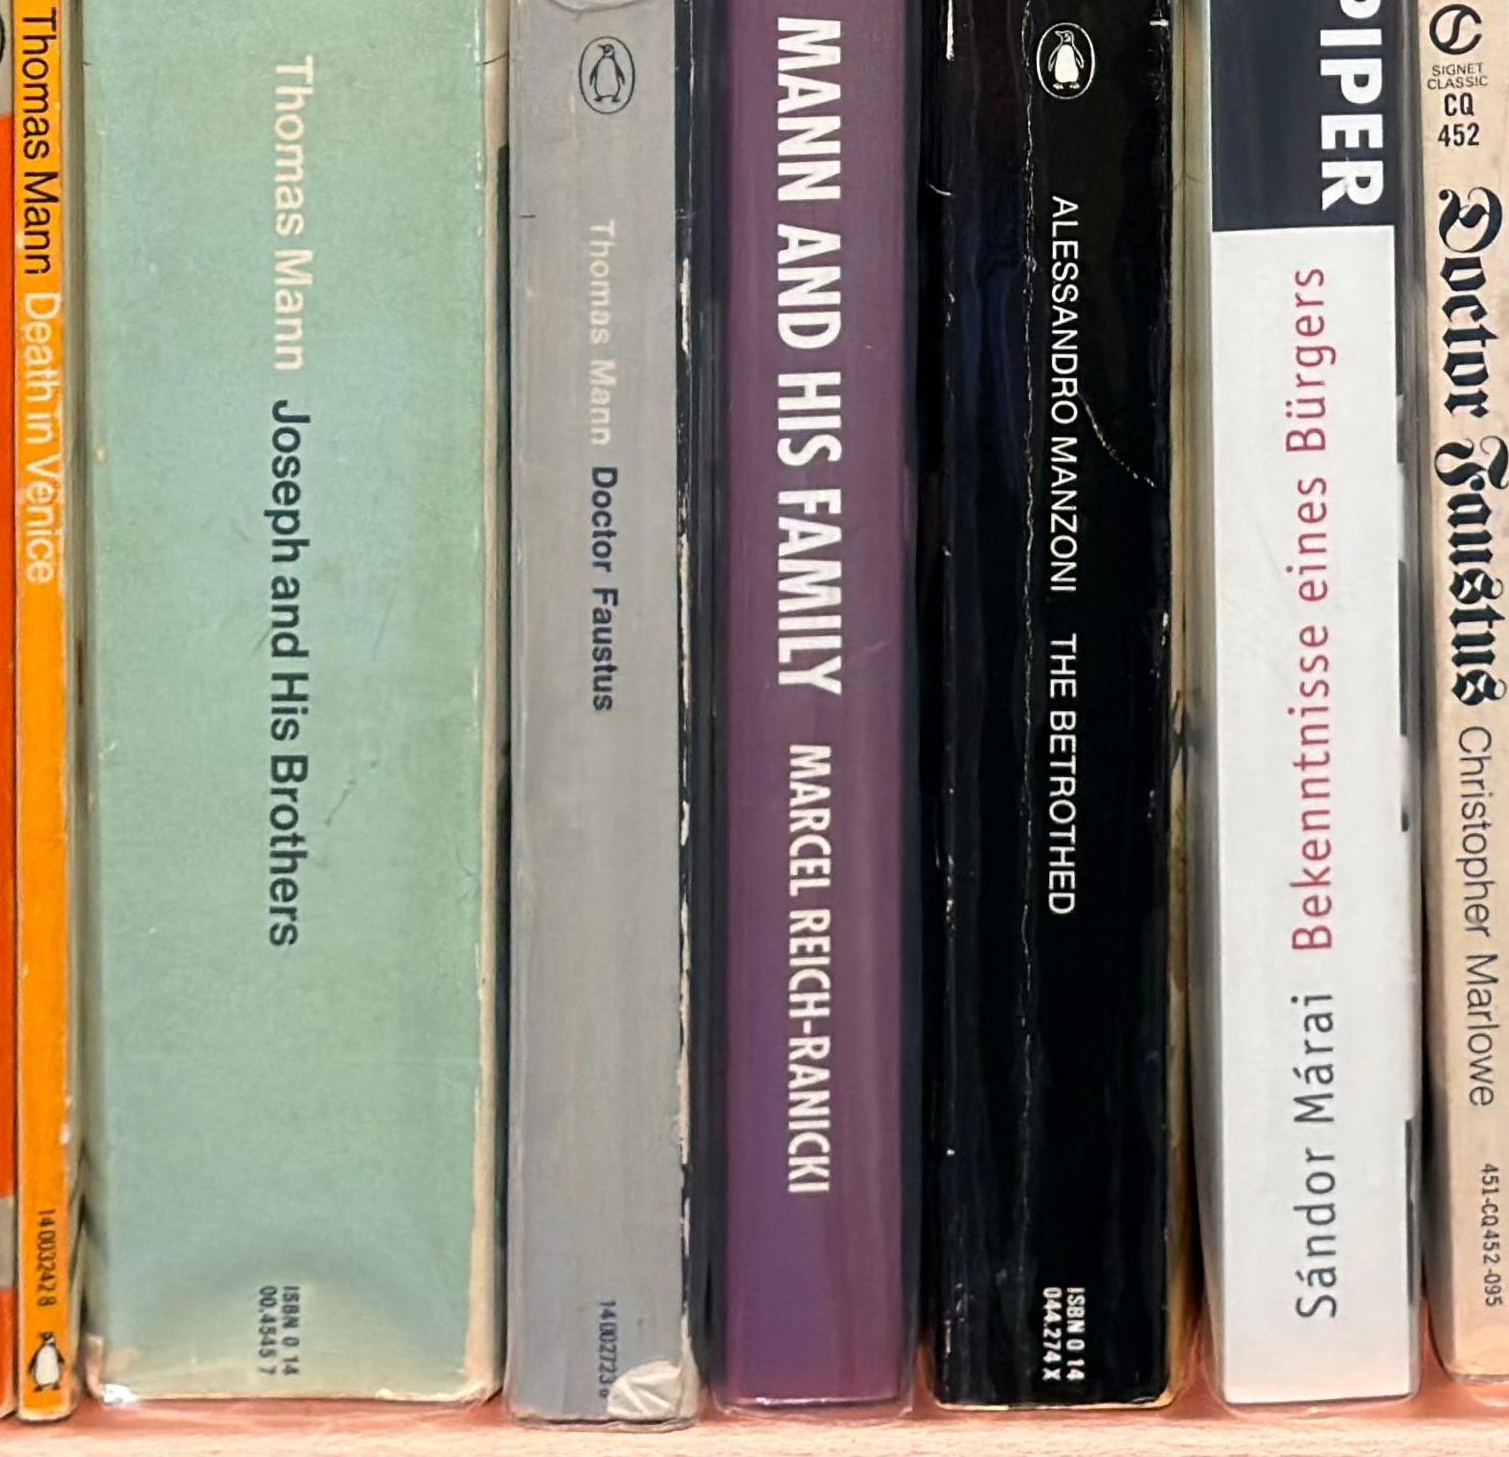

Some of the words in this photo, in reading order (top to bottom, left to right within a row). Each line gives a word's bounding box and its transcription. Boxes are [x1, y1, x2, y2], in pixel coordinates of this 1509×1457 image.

[21, 8, 57, 158] Thomas
[777, 19, 841, 201] MANN
[1426, 76, 1489, 89] CLASSIC
[1432, 64, 1484, 76] SIGNET
[1444, 95, 1474, 118] CQ
[275, 55, 314, 237] Thomas
[1437, 123, 1480, 147] 452
[24, 169, 59, 274] Mann
[590, 220, 615, 345] Thomas
[275, 249, 314, 371] Mann
[777, 224, 841, 352] AND
[1051, 196, 1079, 425] ALESSANDRO
[1437, 186, 1503, 416] Doctor
[24, 292, 59, 412] Death
[590, 355, 616, 446] Mann
[1286, 267, 1337, 451] Bürgers
[26, 421, 60, 444] in
[263, 399, 311, 565] Joseph
[778, 373, 842, 466] HIS
[25, 453, 61, 585] Venice
[591, 467, 618, 572] Doctor
[1050, 437, 1077, 592] MANZONI
[1286, 475, 1329, 602] eines
[1436, 434, 1509, 706] Faustus
[269, 576, 309, 657] and
[592, 585, 618, 711] Faustus
[778, 491, 842, 695] FAMILY
[269, 671, 309, 741] His
[1049, 634, 1077, 698] THE
[268, 754, 309, 947] Brothers
[788, 745, 832, 898] MARCEL
[1048, 710, 1077, 917] BETROTHED
[1289, 625, 1333, 950] Bekenntnisse
[1456, 725, 1494, 940] Christopher
[787, 910, 832, 1194] REICH-RANICKI
[1291, 993, 1335, 1120] Márai
[1465, 954, 1498, 1107] Marlowe
[1295, 1146, 1337, 1320] Sándor
[1042, 1287, 1063, 1363] 044.274
[1066, 1287, 1086, 1334] ISBN
[1066, 1339, 1085, 1350] 0
[1066, 1358, 1085, 1381] 14
[1042, 1368, 1061, 1381] X
